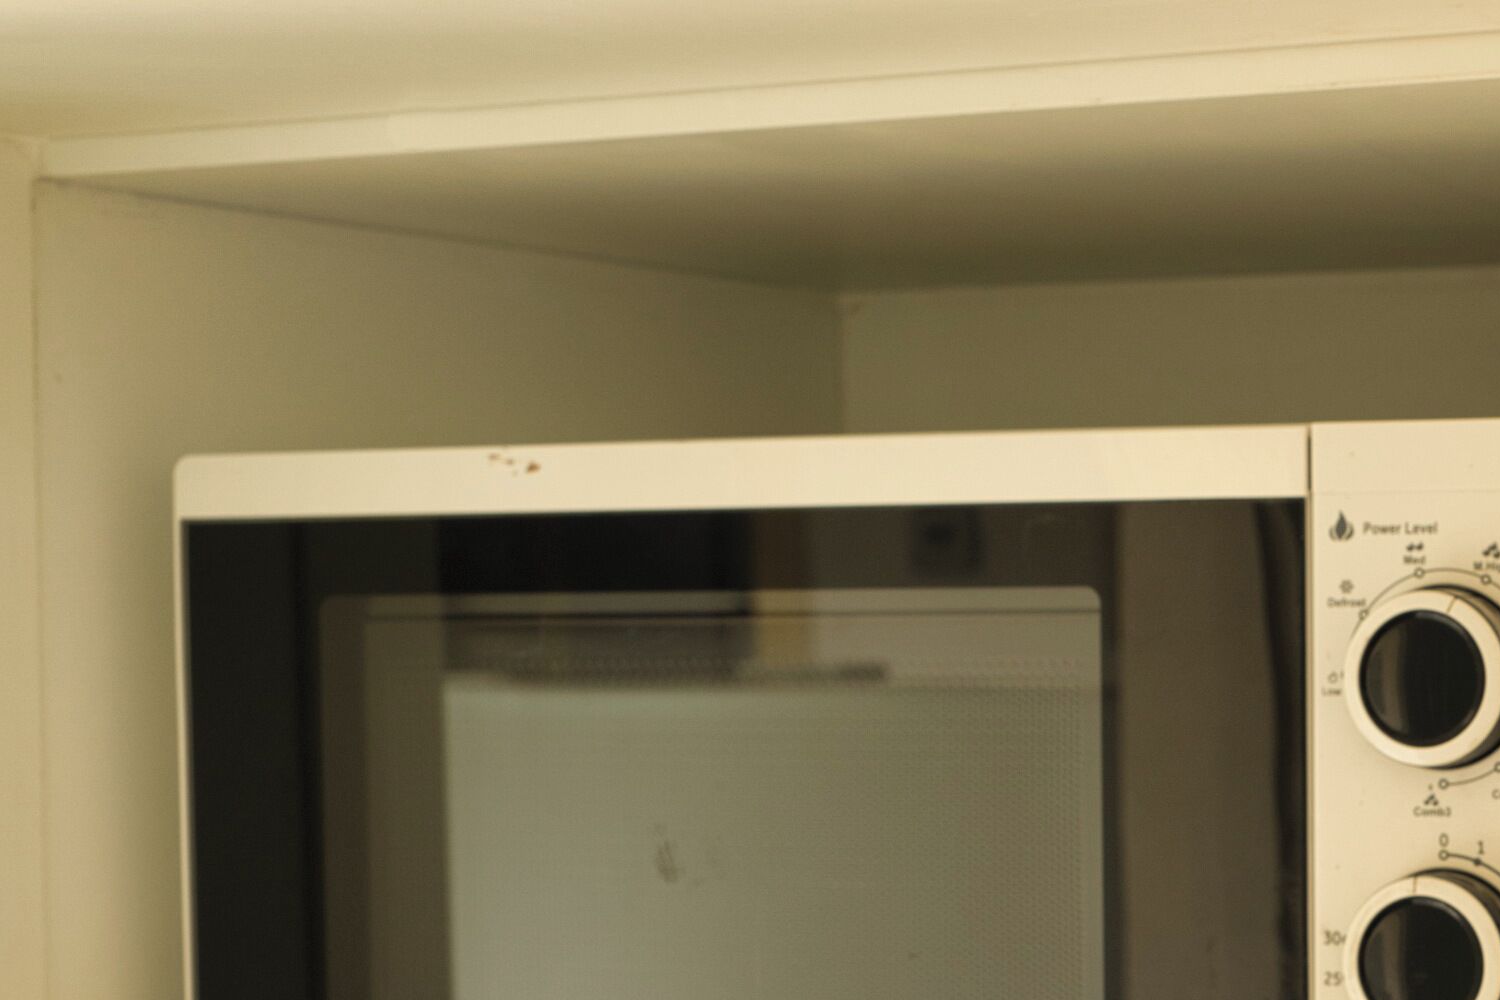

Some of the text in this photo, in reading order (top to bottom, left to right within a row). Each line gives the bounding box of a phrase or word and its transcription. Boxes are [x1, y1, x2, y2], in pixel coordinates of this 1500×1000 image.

[1363, 522, 1438, 535] Power Level
[1404, 556, 1426, 565] Med
[1327, 597, 1366, 607] Defrost
[1439, 833, 1449, 847] 0
[1477, 840, 1484, 855] 1
[1323, 931, 1342, 945] 30
[1324, 971, 1343, 986] 25
